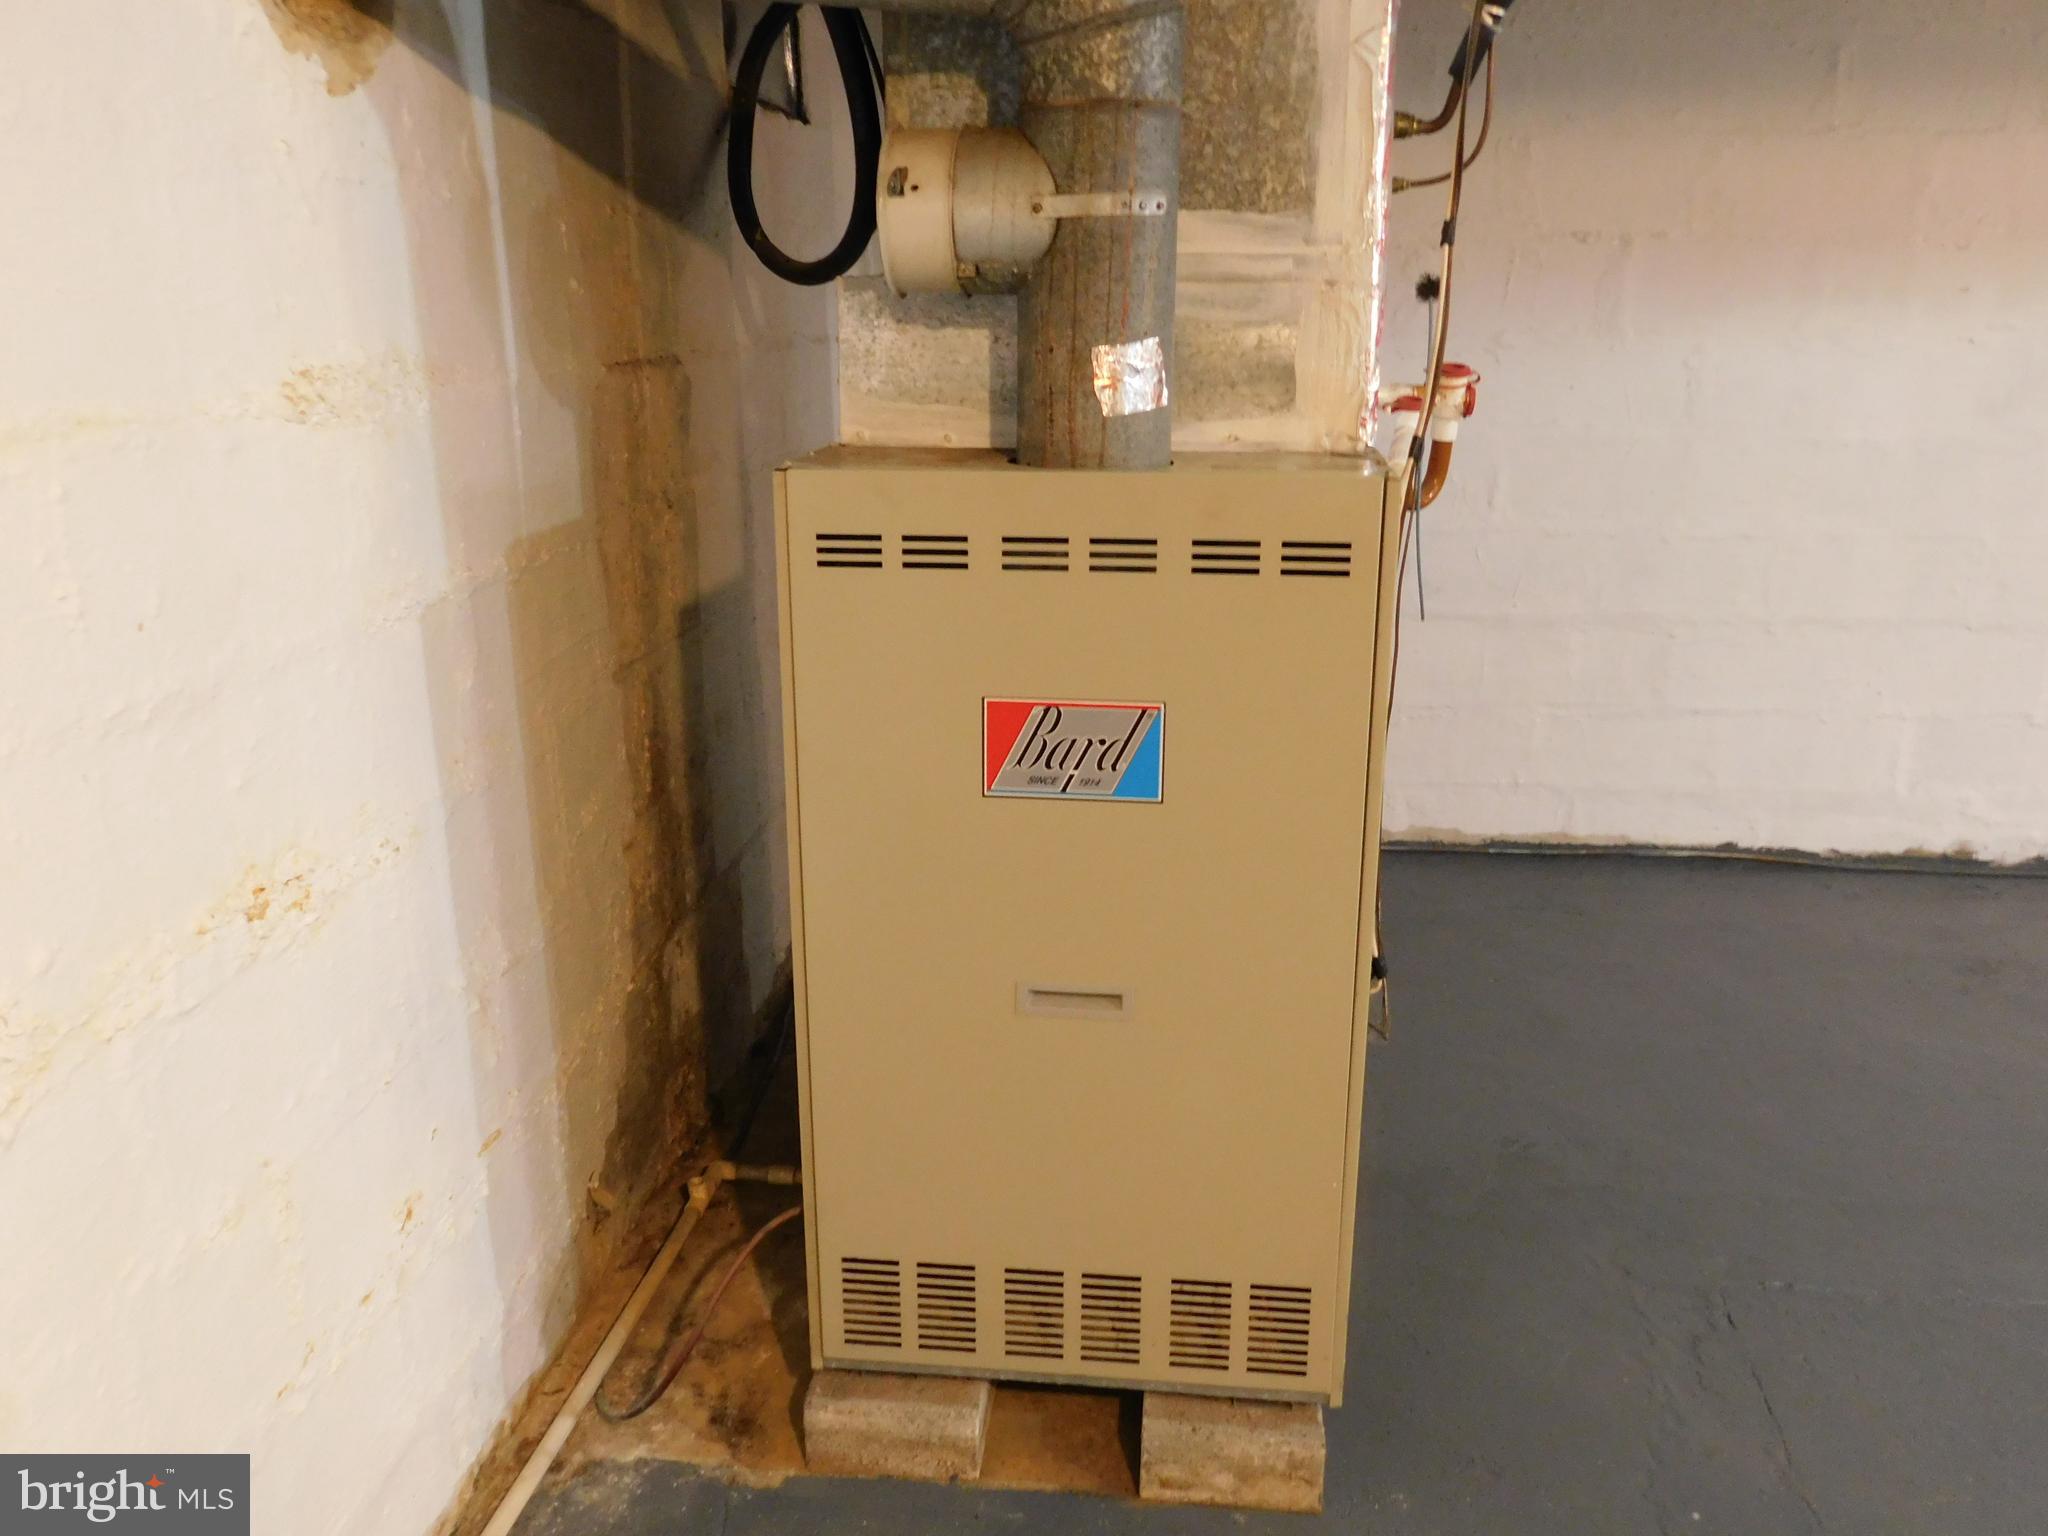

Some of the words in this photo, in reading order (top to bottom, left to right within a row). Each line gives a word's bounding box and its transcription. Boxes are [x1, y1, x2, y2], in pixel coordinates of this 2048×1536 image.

[1012, 705, 1148, 773] Bard
[1027, 775, 1059, 786] SINCE
[1079, 777, 1102, 787] 1914
